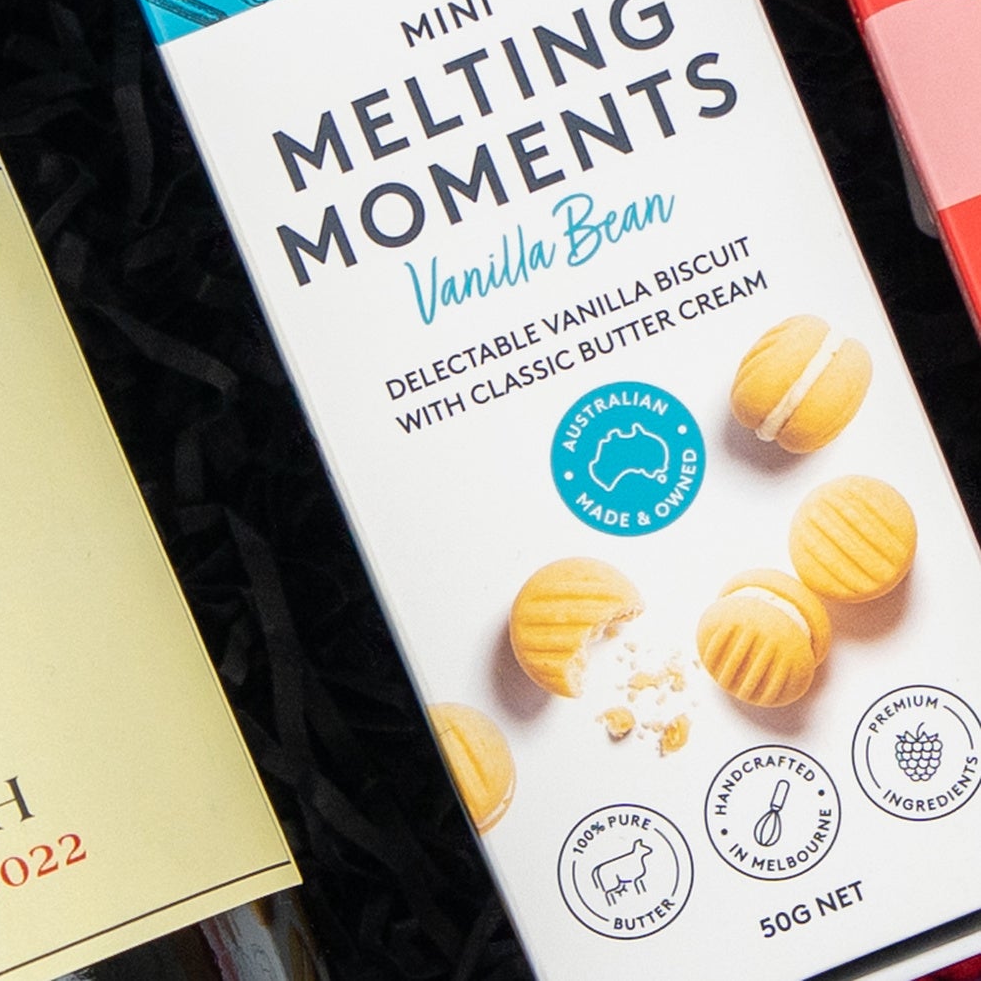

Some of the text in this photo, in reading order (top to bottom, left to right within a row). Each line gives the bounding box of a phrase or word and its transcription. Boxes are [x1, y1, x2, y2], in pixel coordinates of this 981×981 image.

[276, 52, 737, 287] MOMENTS
[404, 192, 675, 326] Vanilla Bean
[385, 236, 751, 401] DELECTABLE VANILLA BISCUIT
[395, 270, 769, 435] WITH CLASSIC BUTTER CREAM
[562, 391, 669, 453] AUSTRALIAN
[575, 449, 698, 528] MADE & OWNED
[869, 695, 938, 734] PREMIUM
[715, 755, 816, 815] HANDCRAFTED
[883, 756, 978, 812] INGREDIENTS
[573, 814, 652, 855] 100% PURE
[729, 808, 832, 871] IN MELBOURNE
[613, 898, 676, 931] BUTTER
[759, 880, 864, 938] 50G NET
